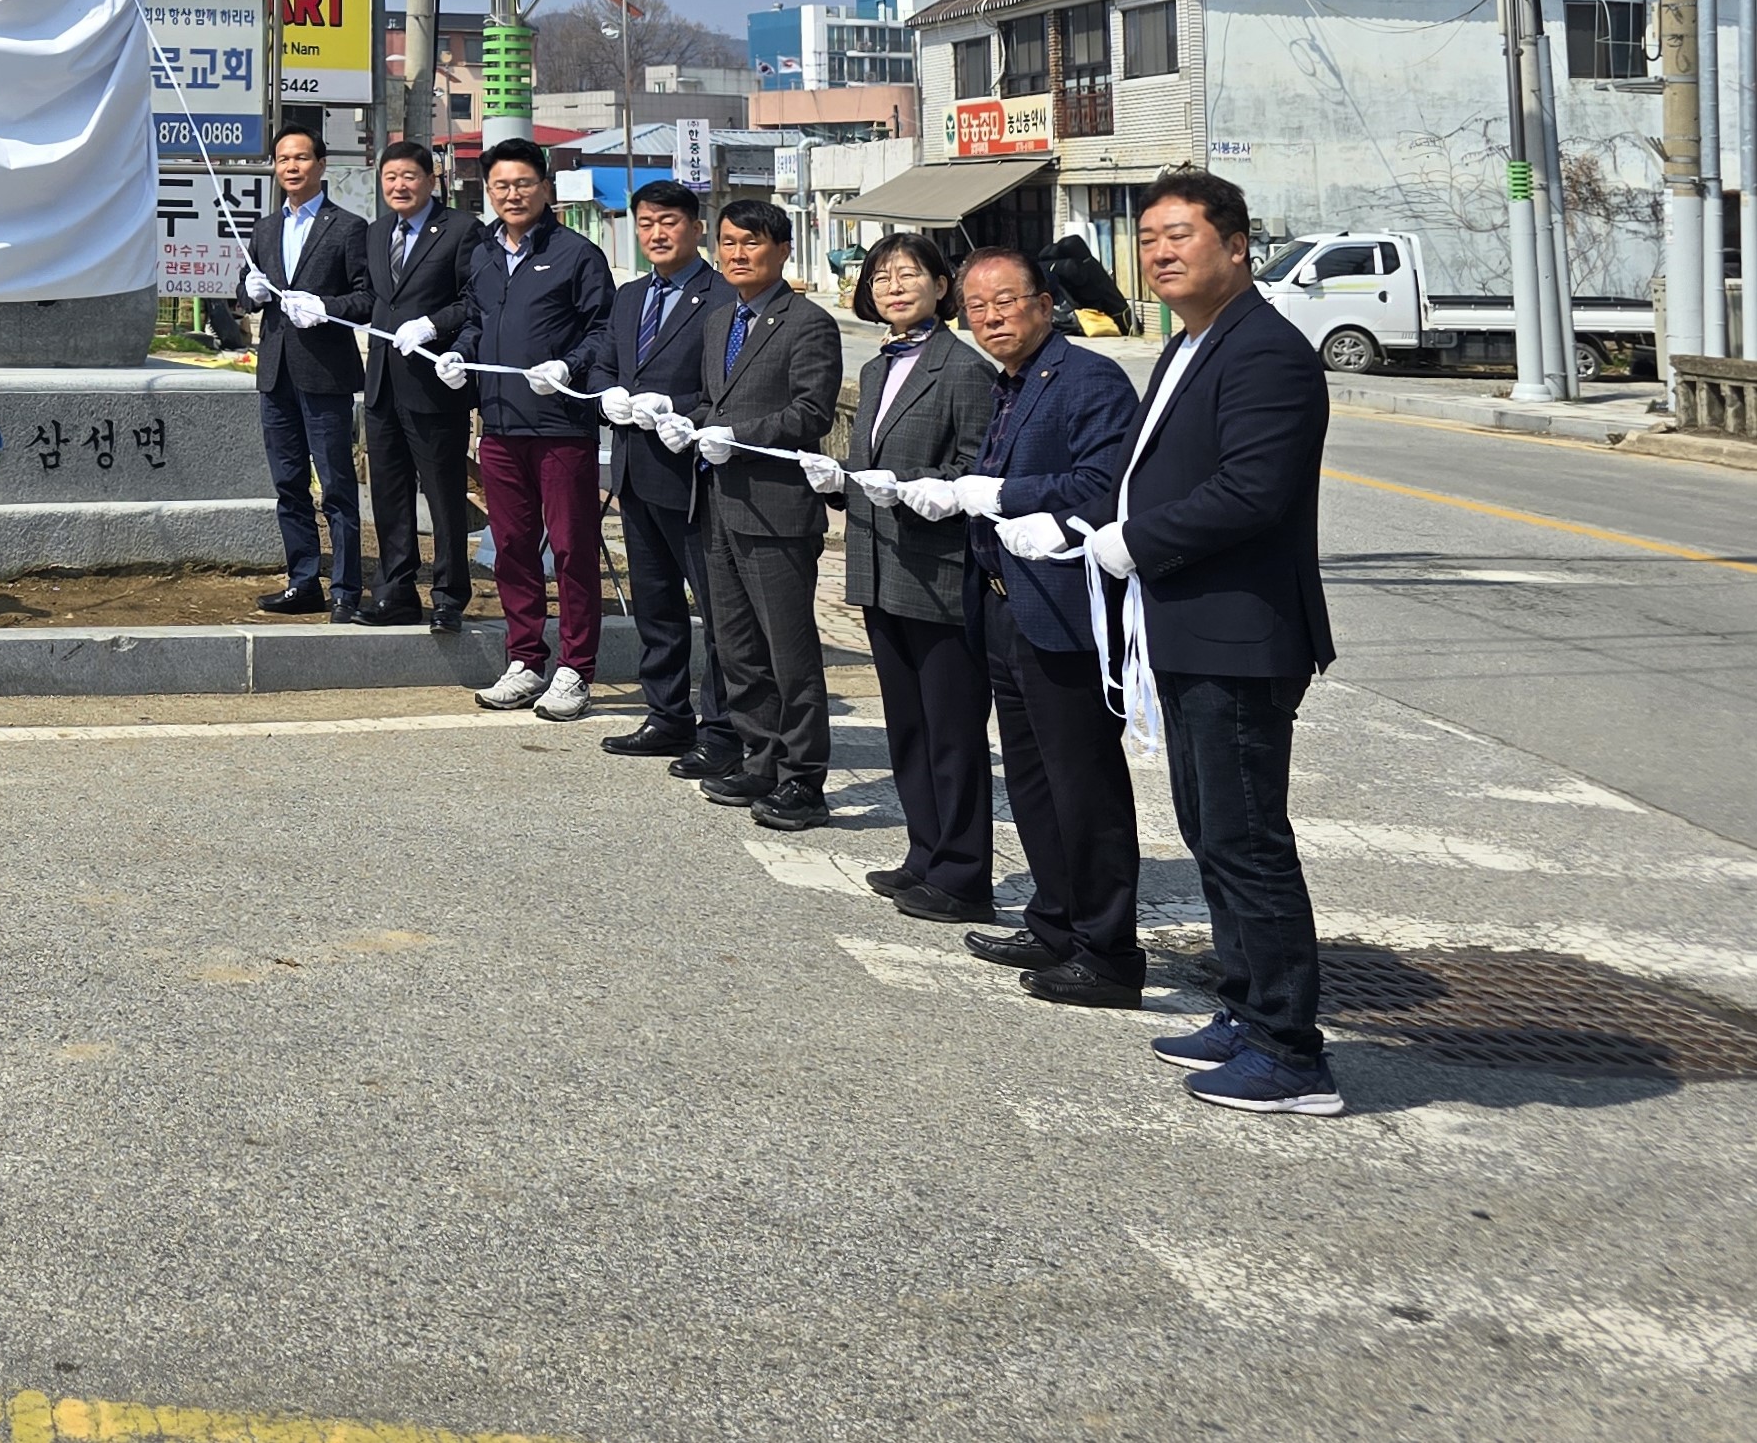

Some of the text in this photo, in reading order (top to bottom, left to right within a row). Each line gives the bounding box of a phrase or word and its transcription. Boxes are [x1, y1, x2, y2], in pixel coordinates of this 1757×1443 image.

[169, 7, 192, 26] 항상
[194, 8, 217, 27] 함께
[220, 9, 255, 27] 하리라
[291, 44, 320, 56] Nam
[150, 47, 253, 92] 문교회
[960, 111, 1001, 143] 흥농종묘
[687, 129, 702, 182] 한중산업
[1211, 141, 1251, 155] 지붕공사
[164, 244, 209, 258] 하수구
[165, 261, 219, 276] 관로탐지
[24, 418, 168, 470] 삼성면
